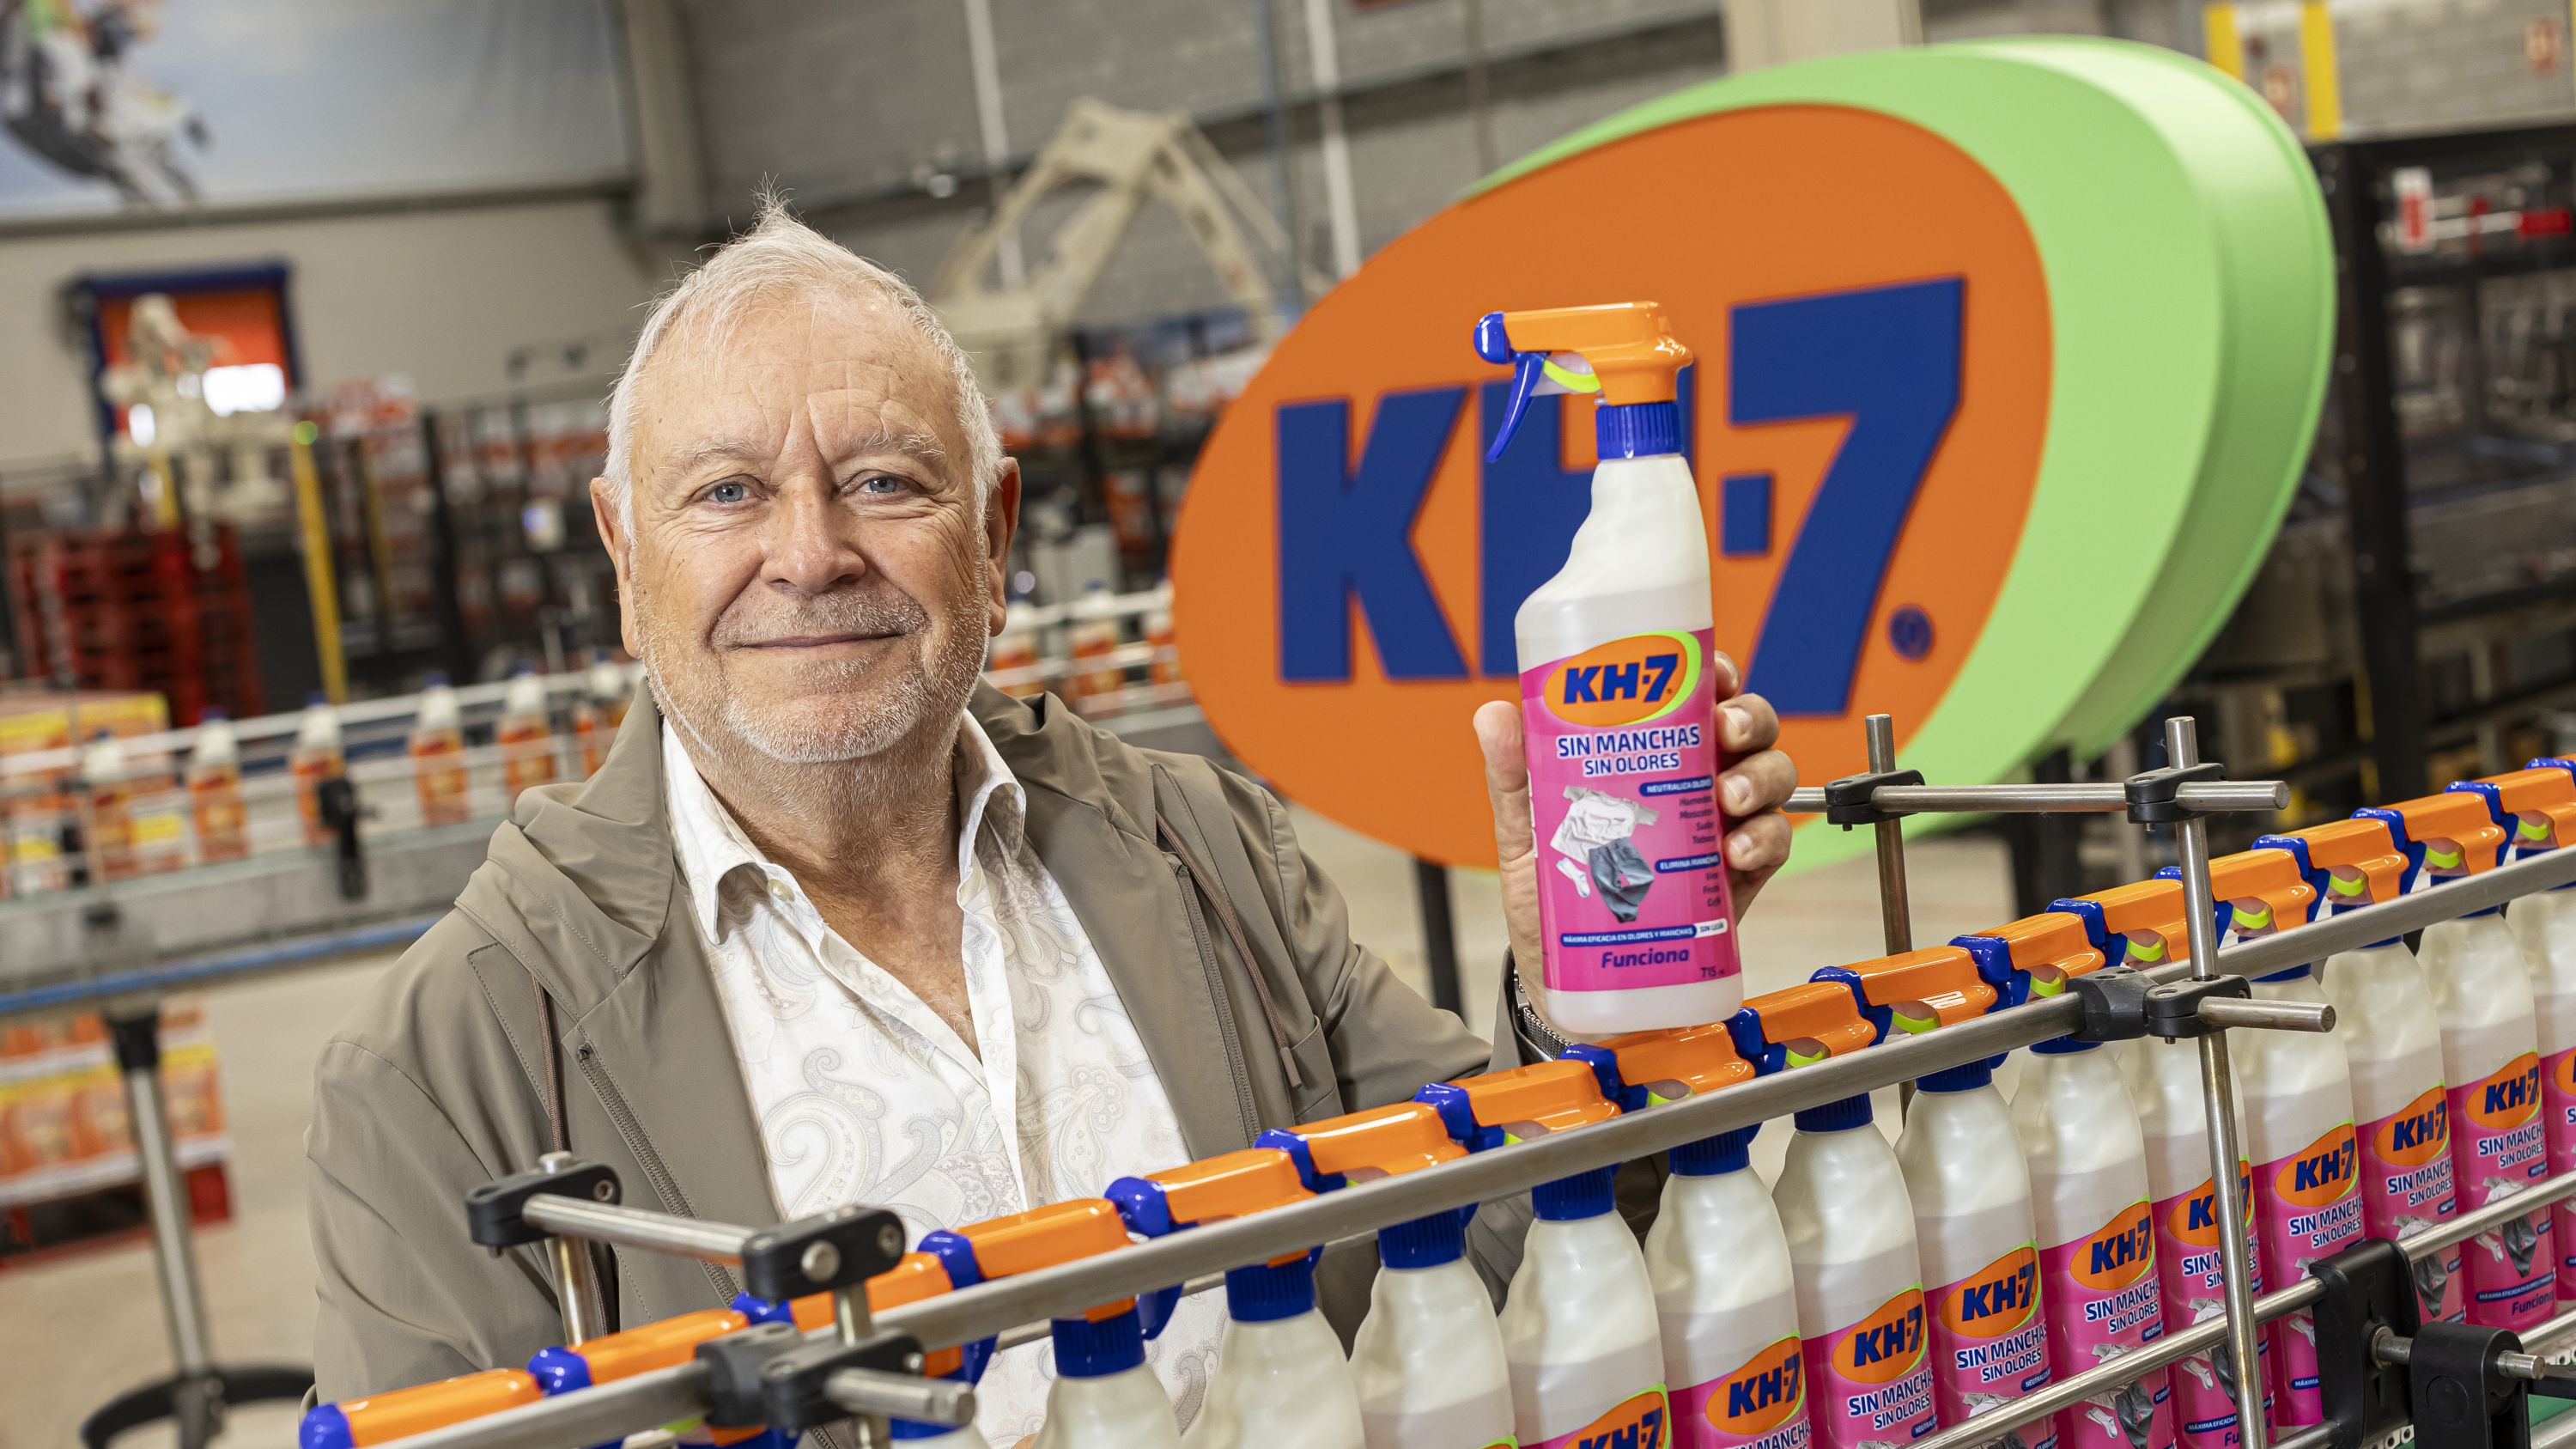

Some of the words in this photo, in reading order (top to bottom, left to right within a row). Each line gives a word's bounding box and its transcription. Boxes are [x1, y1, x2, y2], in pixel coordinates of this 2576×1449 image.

[1564, 654, 1678, 704] KH-7
[1558, 736, 1590, 757] SIN
[1596, 726, 1700, 754] MANCHAS
[1584, 758, 1612, 776] SIN
[1615, 752, 1680, 773] OLORES
[1601, 948, 1690, 969] Funciona
[2484, 1064, 2539, 1115] KH-7
[2392, 1099, 2446, 1152] KH-7
[2478, 1136, 2504, 1155] SIN
[2499, 1152, 2515, 1168] SIN
[2516, 1141, 2544, 1163] OLORES
[2294, 1136, 2354, 1192] KH-7
[2387, 1174, 2413, 1194] SIN
[2409, 1190, 2425, 1206] SIN
[2426, 1177, 2452, 1200] OLORES
[2289, 1215, 2317, 1236] SIN
[2319, 1194, 2364, 1228] MANCHA
[2090, 1215, 2151, 1275] KH-7
[2312, 1231, 2330, 1247] SIN
[2330, 1217, 2361, 1241] OLORES
[2183, 1254, 2211, 1275] SIN
[1961, 1260, 2036, 1322] KH-7
[2512, 1291, 2555, 1315] Funciona
[2085, 1299, 2114, 1321] SIN
[2109, 1315, 2126, 1333] SIN
[2127, 1299, 2159, 1325] OLORES
[1854, 1303, 1923, 1367] KH-7
[1956, 1346, 1987, 1369] SIN
[1982, 1362, 2003, 1382] SIN
[2004, 1347, 2042, 1373] OLORES
[1728, 1352, 1800, 1419] KH-7
[1849, 1392, 1880, 1416] SIN
[1881, 1368, 1932, 1408] MANCHA
[1874, 1409, 1894, 1429] SIN
[1895, 1392, 1931, 1422] OLORES
[2188, 1421, 2213, 1431] MÁXIMA
